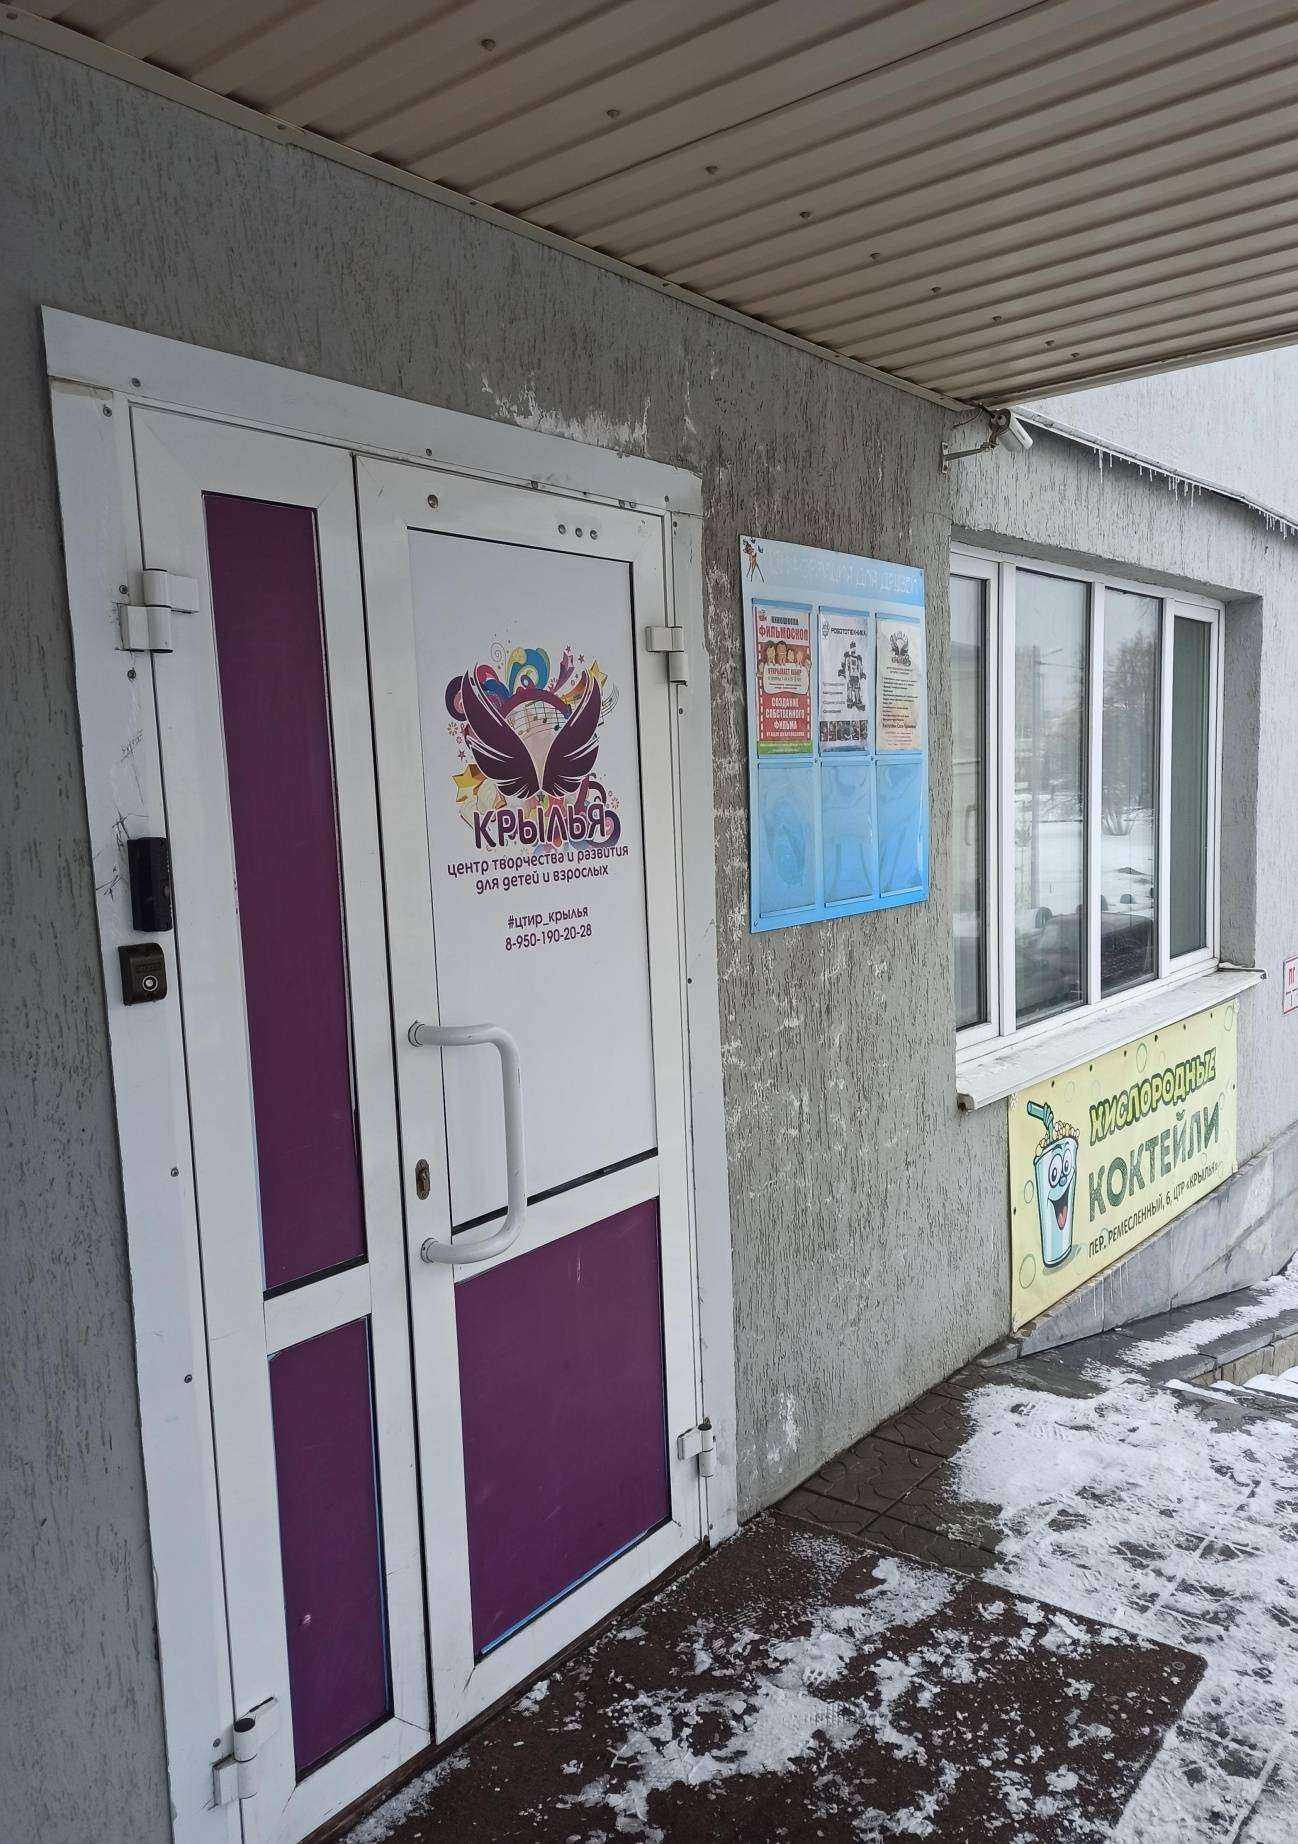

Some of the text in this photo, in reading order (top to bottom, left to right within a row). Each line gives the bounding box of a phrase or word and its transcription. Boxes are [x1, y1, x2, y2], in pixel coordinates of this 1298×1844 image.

[759, 625, 808, 641] ФИЛЬМОСКОП
[830, 627, 867, 636] РОБОТОТЕХНИКА
[473, 803, 606, 849] КРЫЛЬЯ
[447, 846, 629, 878] центр творчества и развития
[476, 864, 609, 895] для детей и взрослых
[507, 906, 589, 929] #цтир_крылья
[505, 924, 592, 951] 8-950-190-20-28
[1089, 1047, 1217, 1146] КИСЛОРОДНЫЕ
[1088, 1101, 1220, 1222] КОКТЕЙЛИ
[1089, 1235, 1107, 1258] ПЕР.
[1108, 1193, 1165, 1245] РЕМЕСЛЕННЫЙ,
[1173, 1181, 1185, 1201] ЦТР
